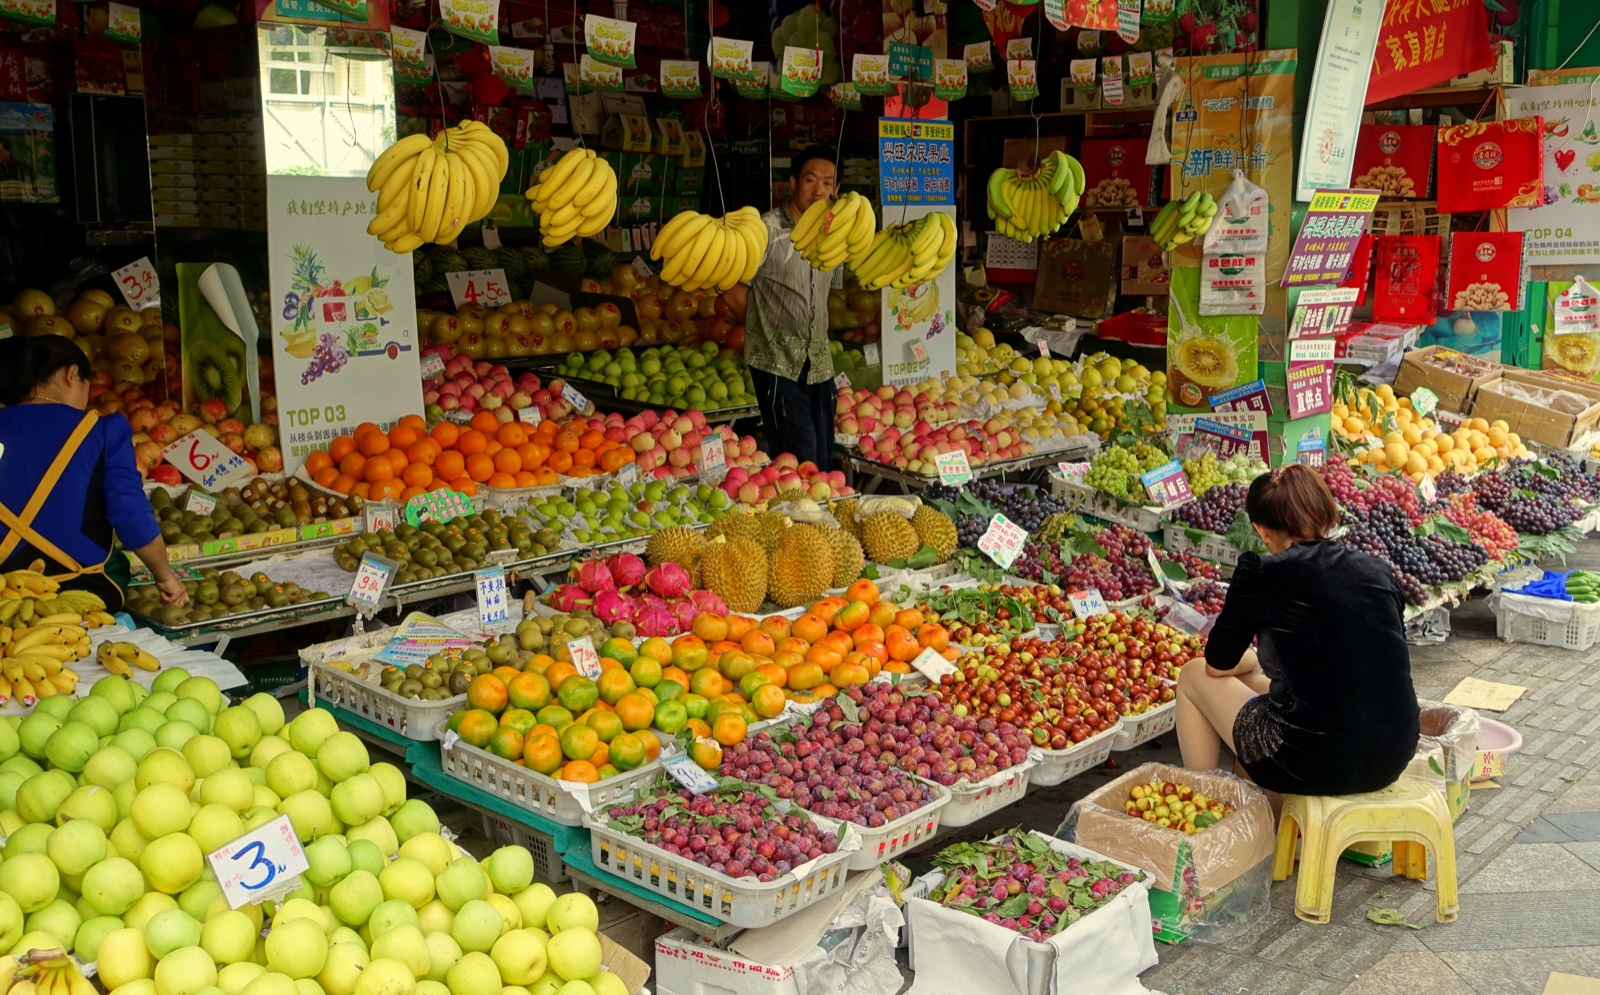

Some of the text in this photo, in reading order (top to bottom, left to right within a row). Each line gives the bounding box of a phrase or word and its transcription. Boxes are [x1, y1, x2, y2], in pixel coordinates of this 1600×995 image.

[1374, 21, 1448, 75] 家直销点
[1520, 97, 1600, 112] 我们坚持用心服
[883, 142, 951, 164] 兴旺农民果业
[1555, 227, 1573, 239] 04
[888, 361, 918, 376] TOP 02
[1296, 387, 1324, 414] 直供点
[286, 404, 346, 427] TOP 03
[289, 430, 339, 444] 从枝头到舌头
[290, 442, 331, 458] 坚持品质
